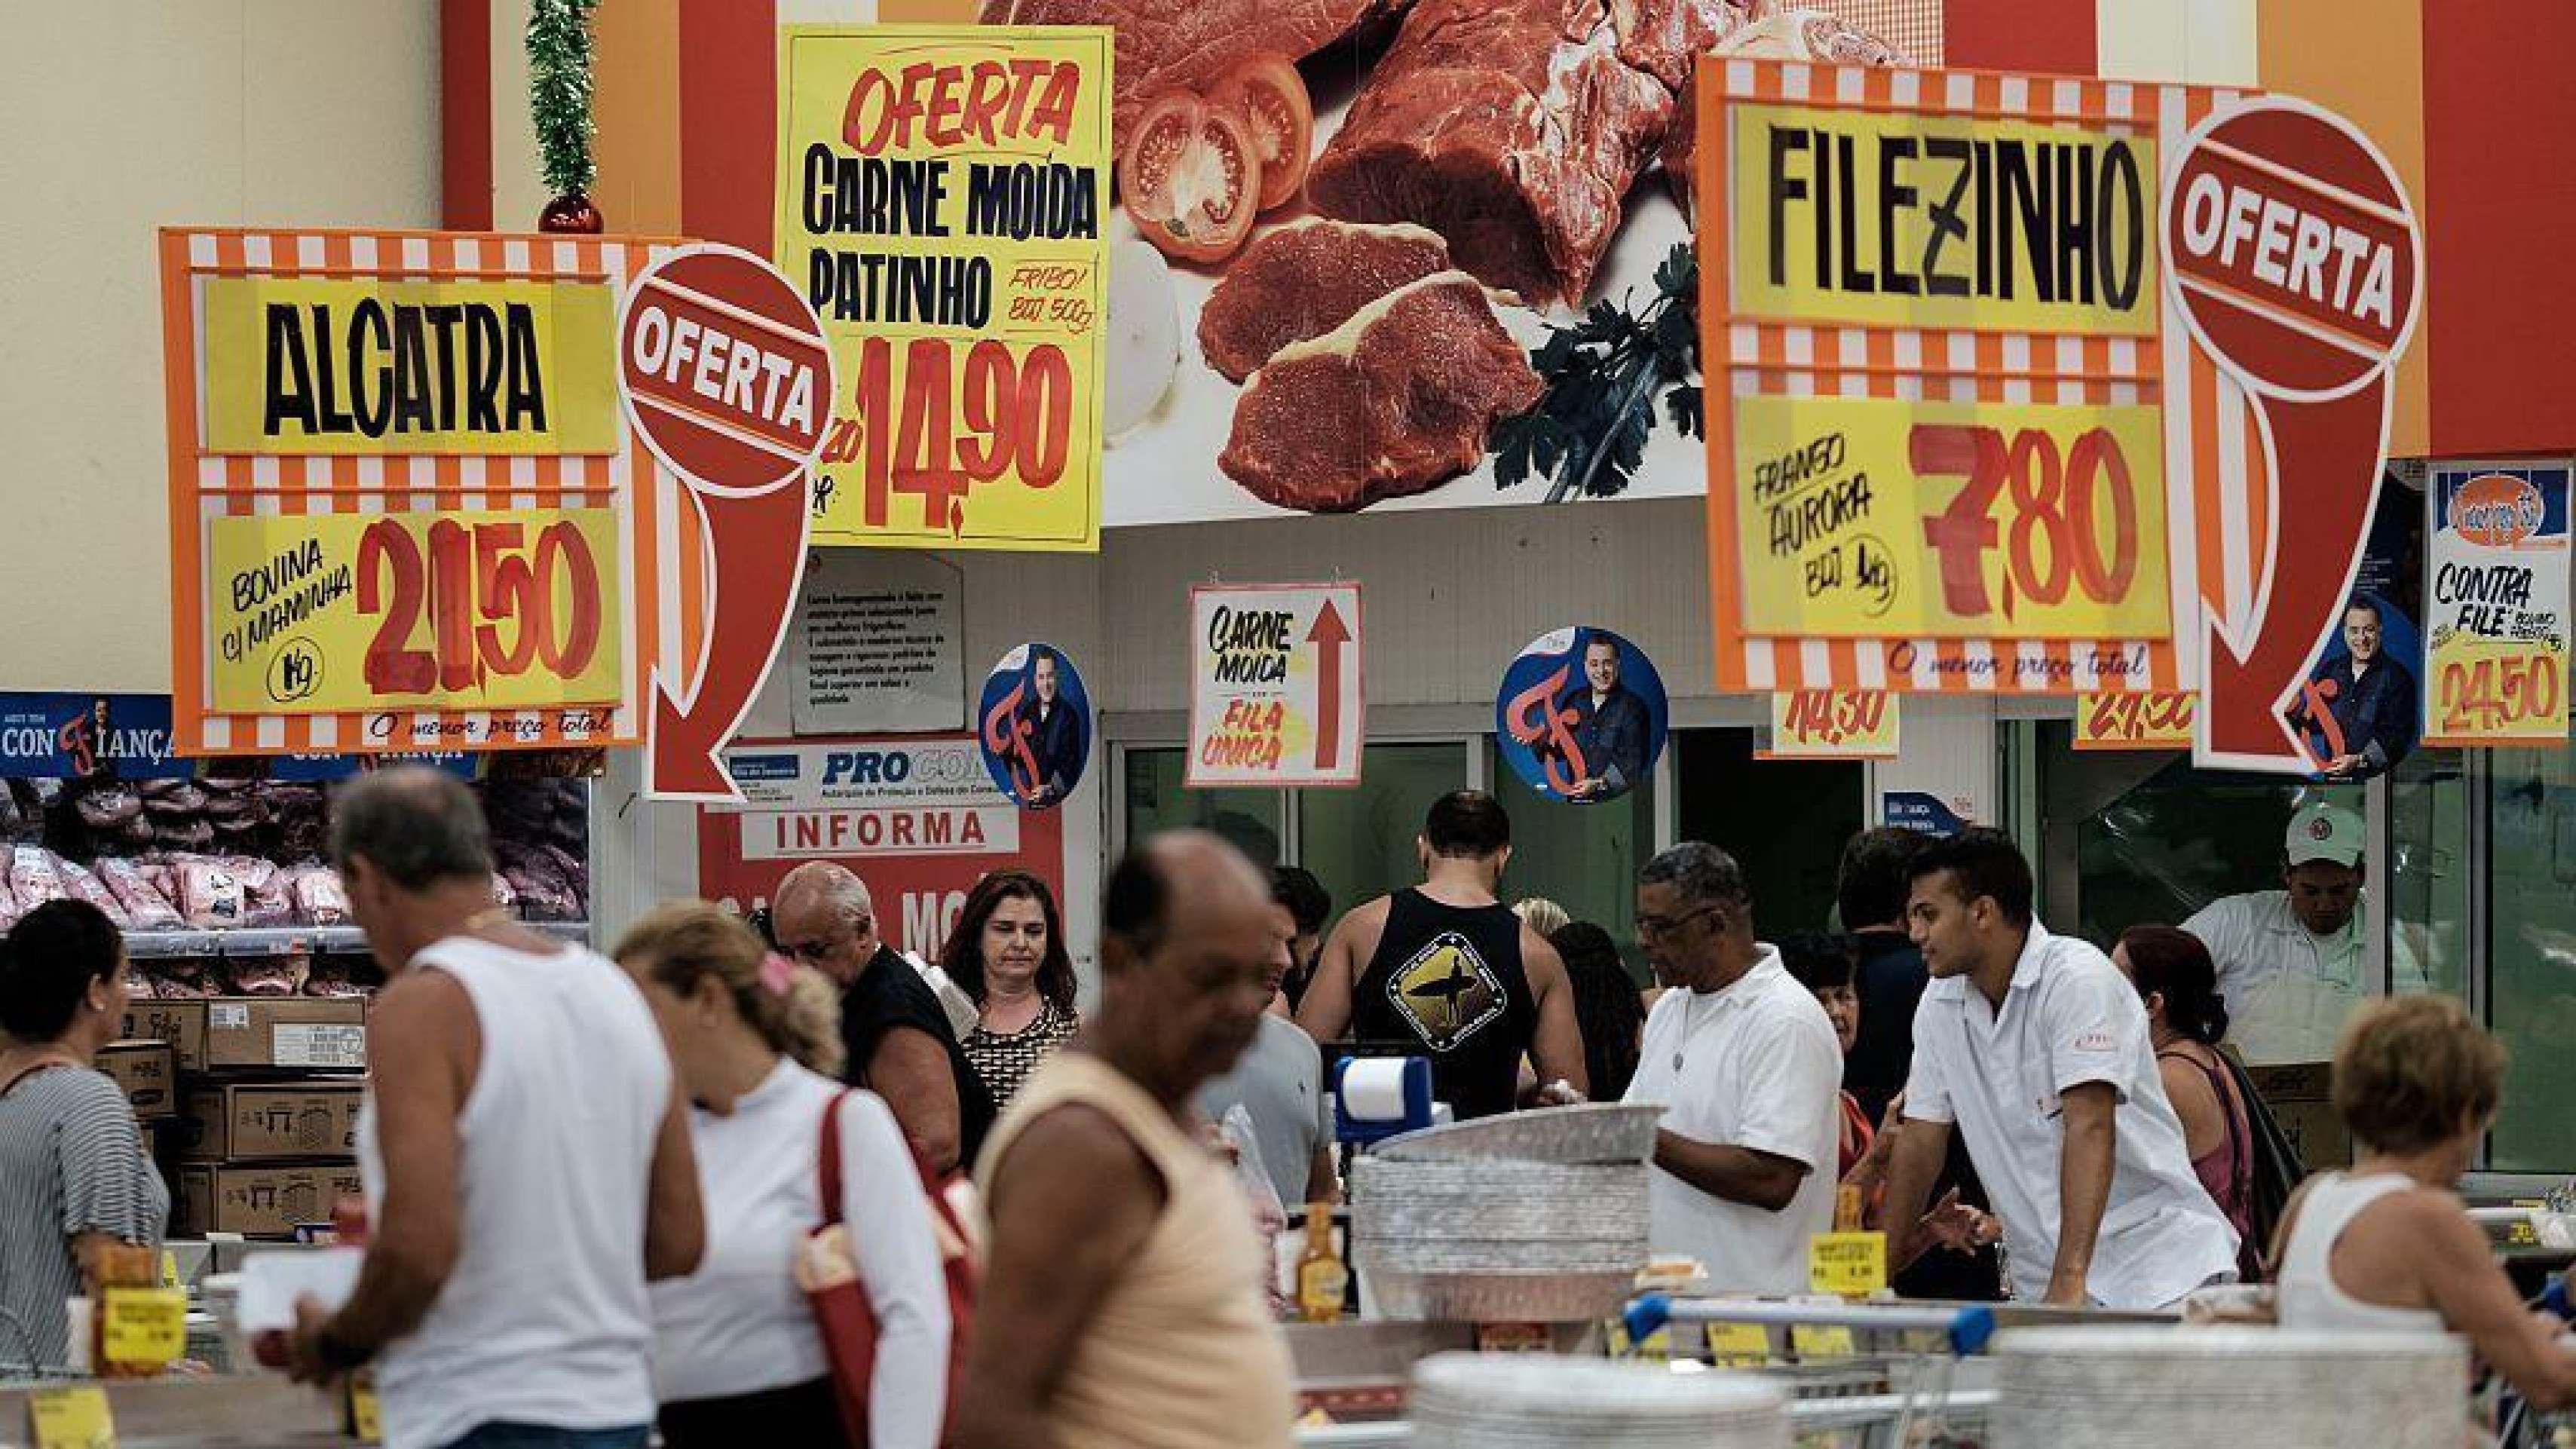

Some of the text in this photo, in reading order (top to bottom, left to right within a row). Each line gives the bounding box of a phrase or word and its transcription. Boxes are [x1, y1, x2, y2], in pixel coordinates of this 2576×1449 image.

[842, 60, 1080, 156] OFERTA
[804, 143, 950, 237] CARNE
[1768, 123, 2143, 311] FILEZINHO
[809, 247, 991, 329] PATINHO
[2182, 172, 2393, 329] OFERTA
[264, 297, 547, 437] ALCATRA
[632, 306, 813, 434] OFERTA
[1754, 432, 1845, 504] FRANGO
[1770, 472, 1873, 556] AURORA
[1908, 422, 2137, 621] 7,80
[232, 538, 322, 612] BOVINA
[248, 563, 352, 651] MAMINHA
[2435, 561, 2533, 606] CONTRA
[1209, 604, 1293, 654] CARNE
[1888, 640, 1918, 672] O
[1928, 651, 2005, 673] menor
[2087, 643, 2146, 675] total
[369, 711, 398, 737] O
[410, 721, 479, 736] menor
[559, 708, 614, 733] total
[776, 810, 985, 849] INFORMA
